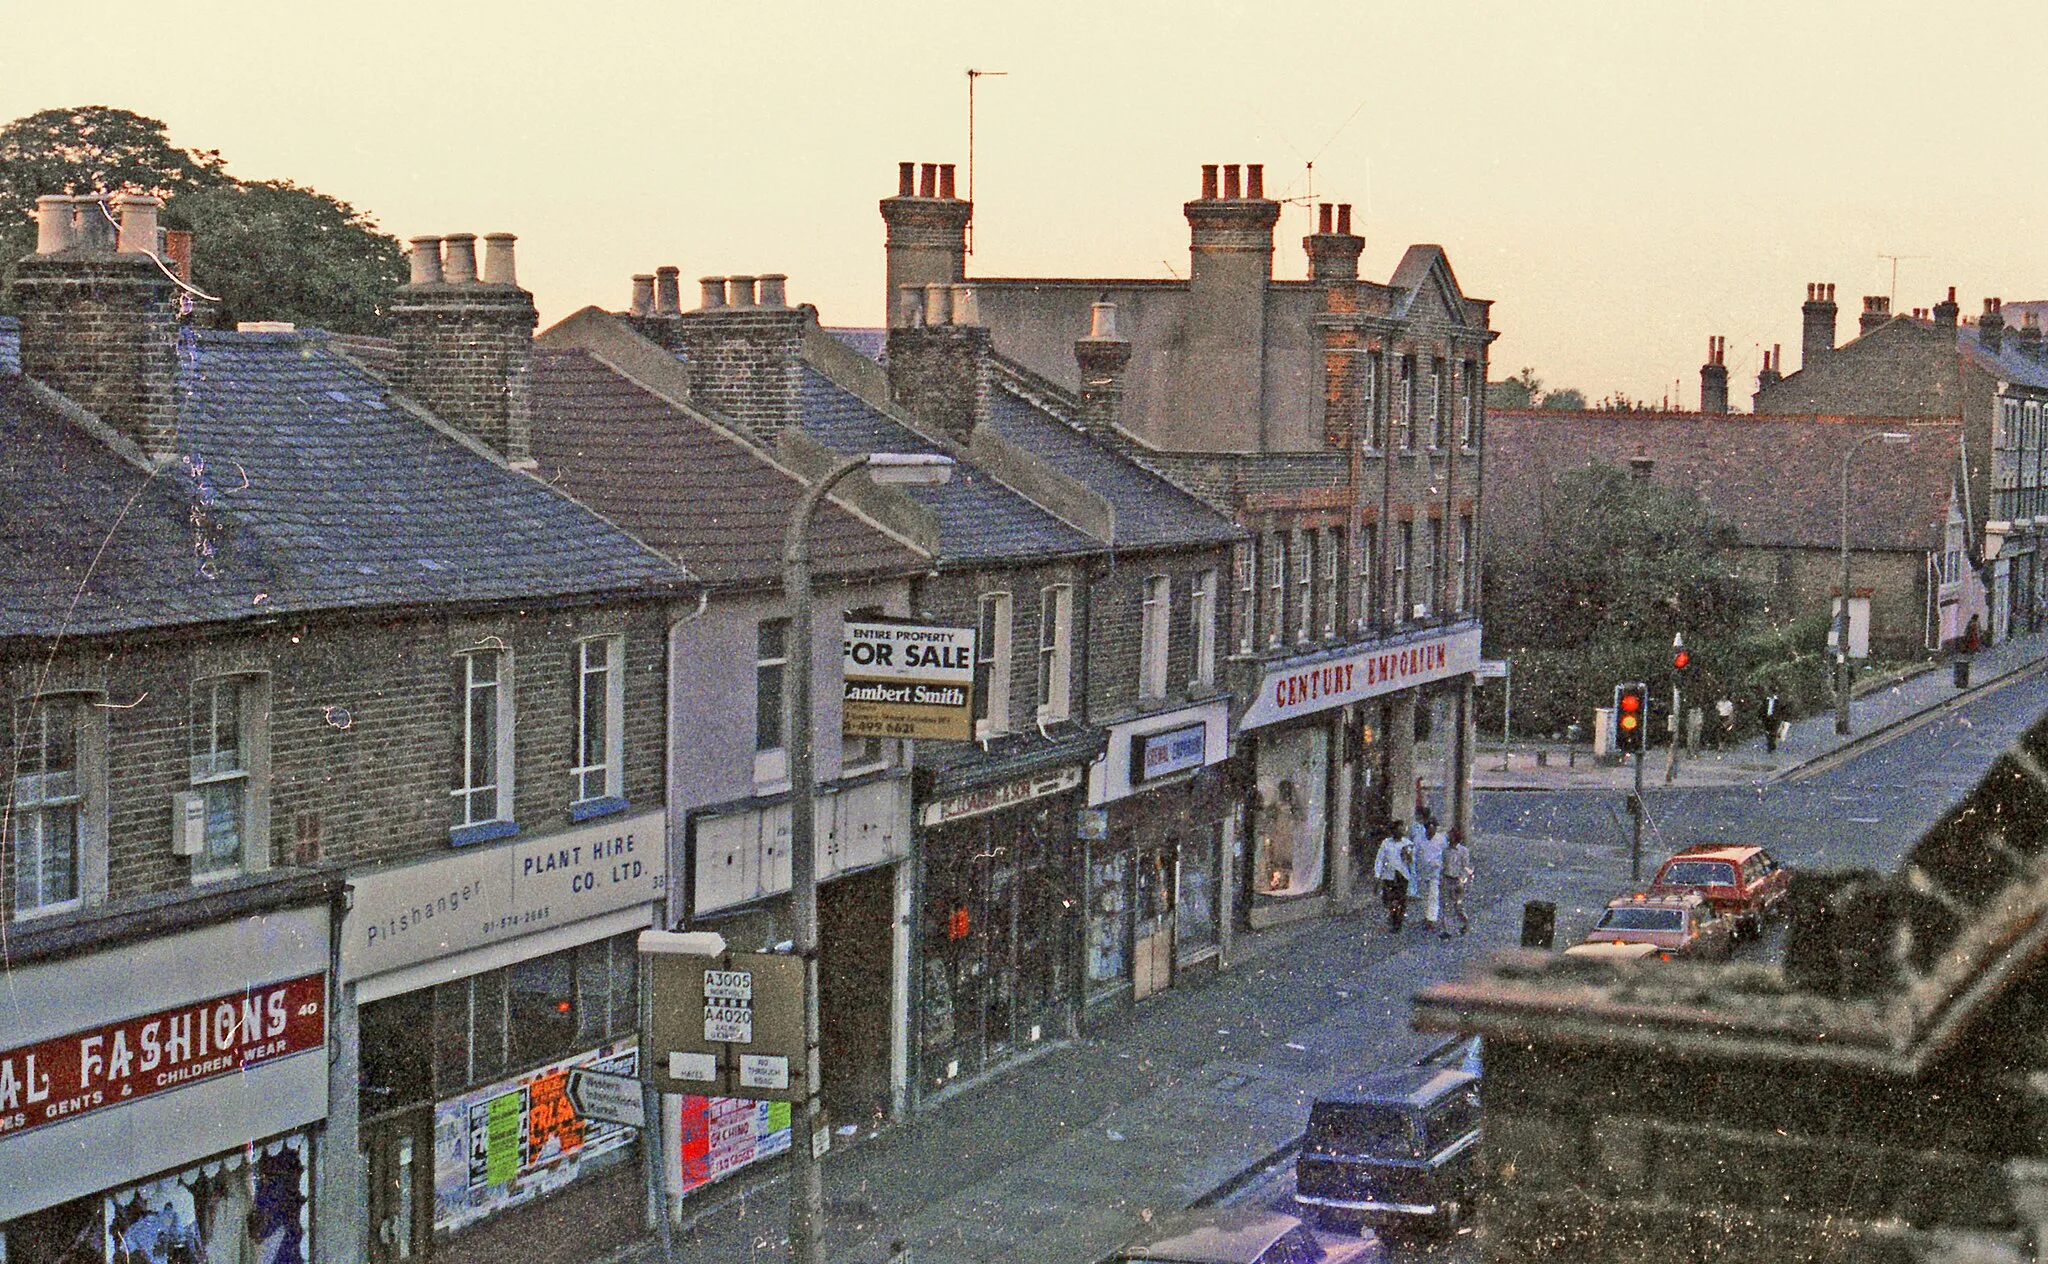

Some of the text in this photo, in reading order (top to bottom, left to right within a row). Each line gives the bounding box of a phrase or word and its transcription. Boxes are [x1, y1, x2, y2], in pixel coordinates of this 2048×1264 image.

[853, 629, 954, 643] ENTIRE PROPERTY
[905, 644, 970, 669] SALE
[1276, 642, 1446, 708] CENTURY EMPORIUM
[843, 682, 964, 705] Lambert Smith
[524, 835, 634, 876] PLANT HIRE
[612, 861, 648, 883] LTD.
[706, 973, 751, 988] A3005
[297, 1002, 318, 1017] 40
[705, 1008, 752, 1024] A4020
[80, 989, 287, 1089] FASHIONS
[46, 1091, 104, 1118] GENTS
[156, 1055, 233, 1087] CHILDREN
[244, 1039, 287, 1061] WEAR
